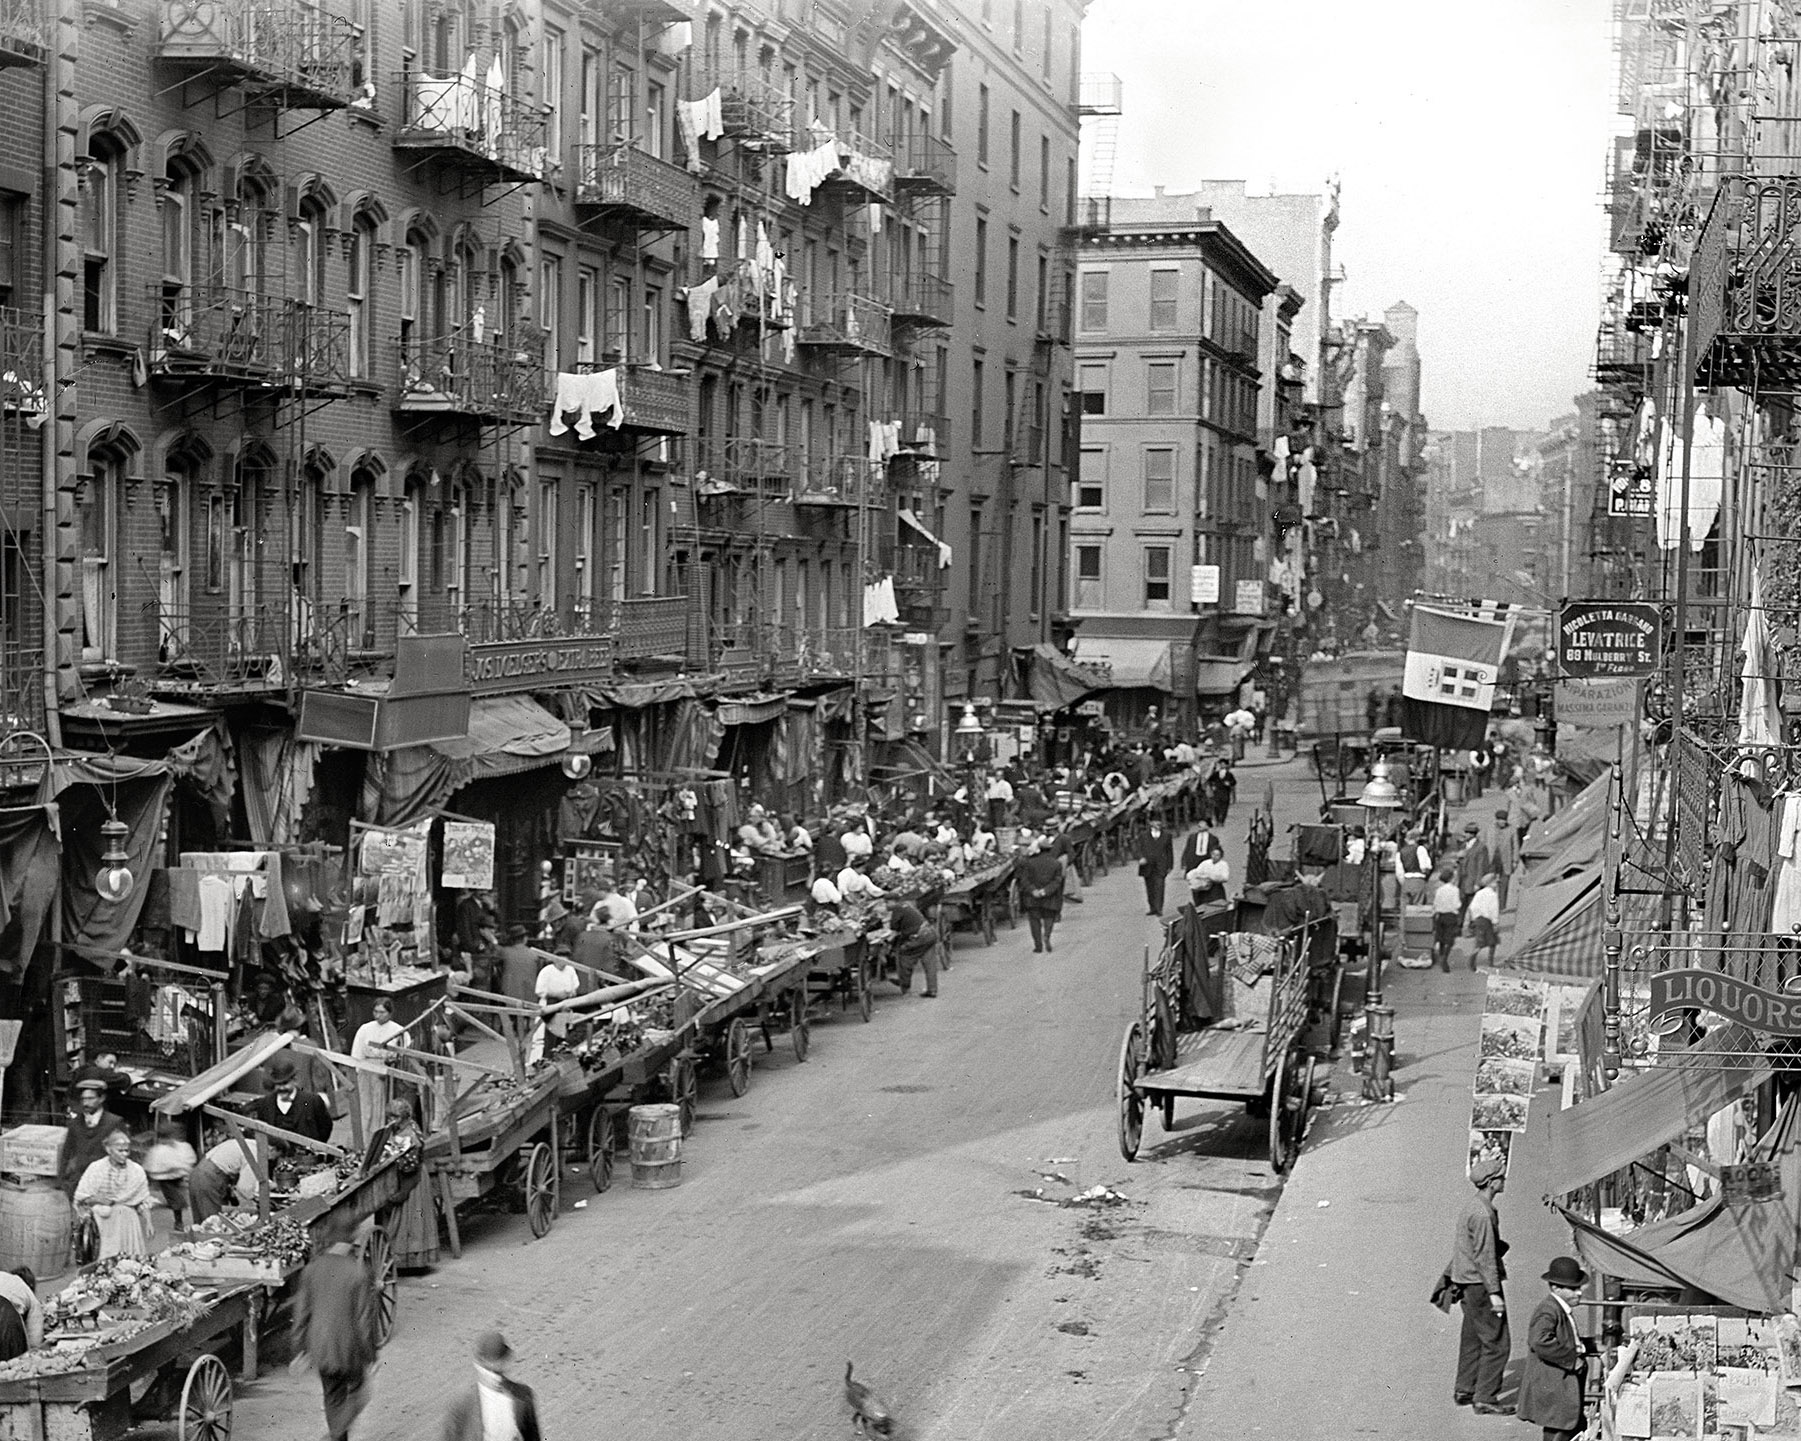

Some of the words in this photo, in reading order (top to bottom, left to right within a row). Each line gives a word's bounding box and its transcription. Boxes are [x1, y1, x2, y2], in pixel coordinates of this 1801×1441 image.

[1562, 610, 1613, 635] NICOLETTA
[1572, 632, 1645, 648] LEVATRICE
[1664, 976, 1801, 1029] LIQUORS
